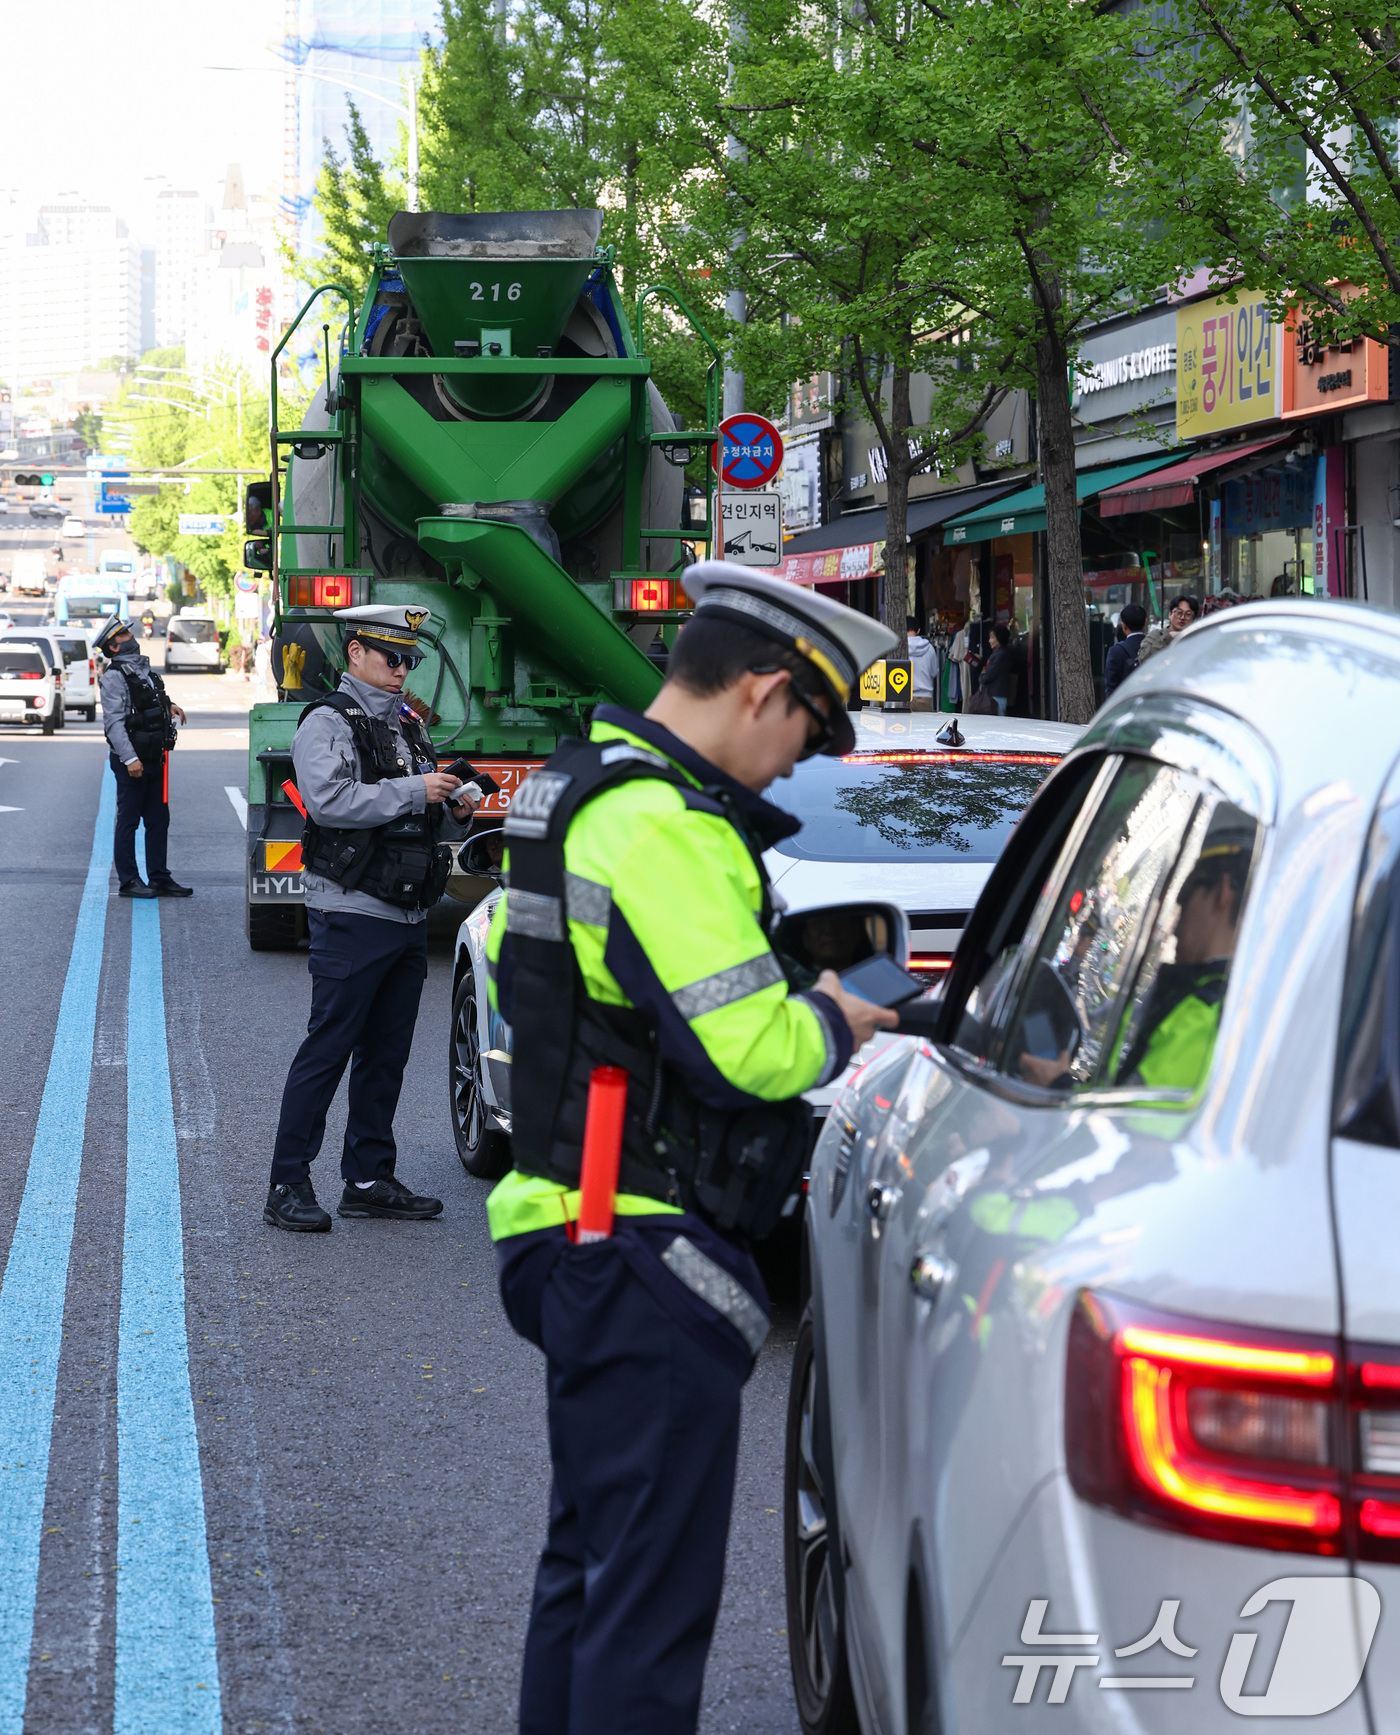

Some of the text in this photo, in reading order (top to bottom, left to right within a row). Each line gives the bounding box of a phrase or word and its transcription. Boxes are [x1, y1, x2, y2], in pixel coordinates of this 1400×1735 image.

[469, 282, 522, 301] 216
[1202, 301, 1271, 414] 풍기인견
[722, 503, 775, 519] 견인지역
[501, 770, 520, 785] 기
[253, 877, 307, 894] HYU
